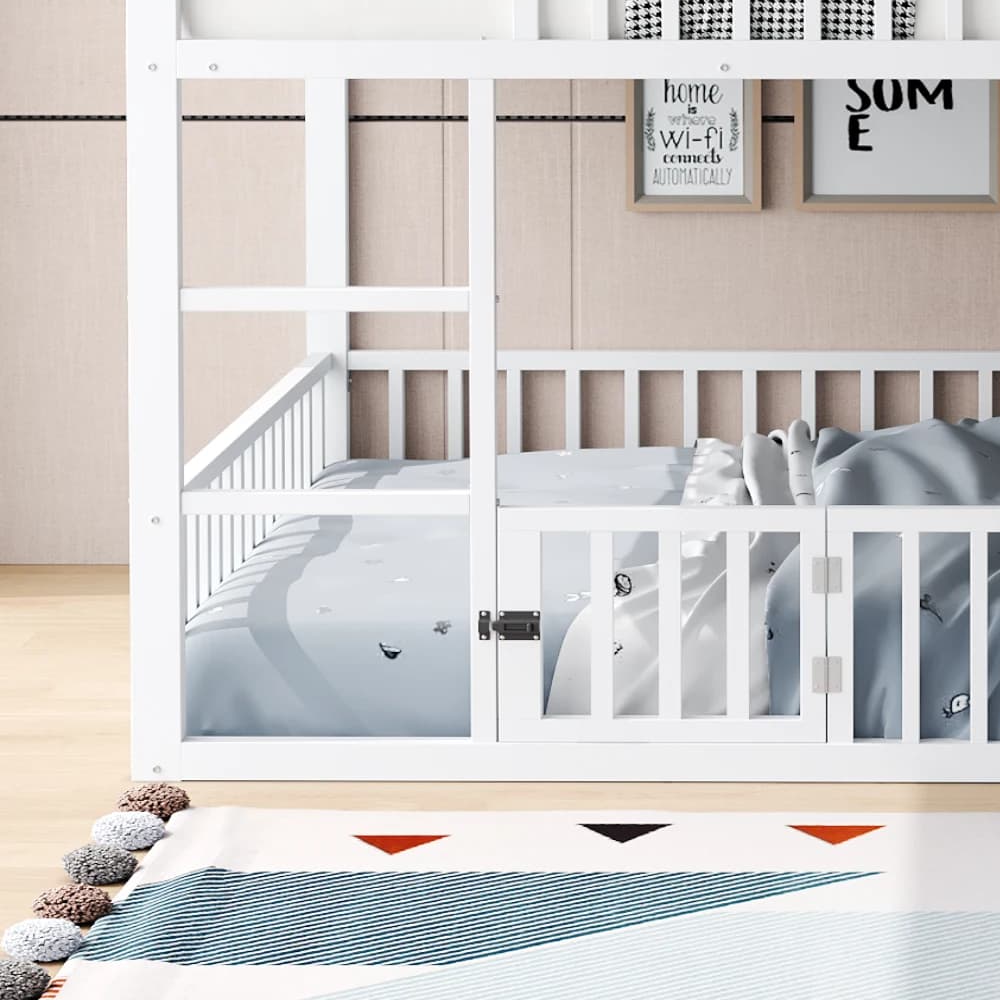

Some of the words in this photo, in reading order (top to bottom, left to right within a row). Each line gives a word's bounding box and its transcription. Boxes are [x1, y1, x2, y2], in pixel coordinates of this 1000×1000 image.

[664, 79, 724, 104] home
[846, 79, 953, 112] SOM
[688, 104, 697, 114] is
[668, 114, 717, 126] where
[660, 127, 723, 149] wi-fi
[848, 114, 873, 151] E
[663, 148, 724, 164] connects
[653, 168, 733, 185] AUTOMATICALLY
